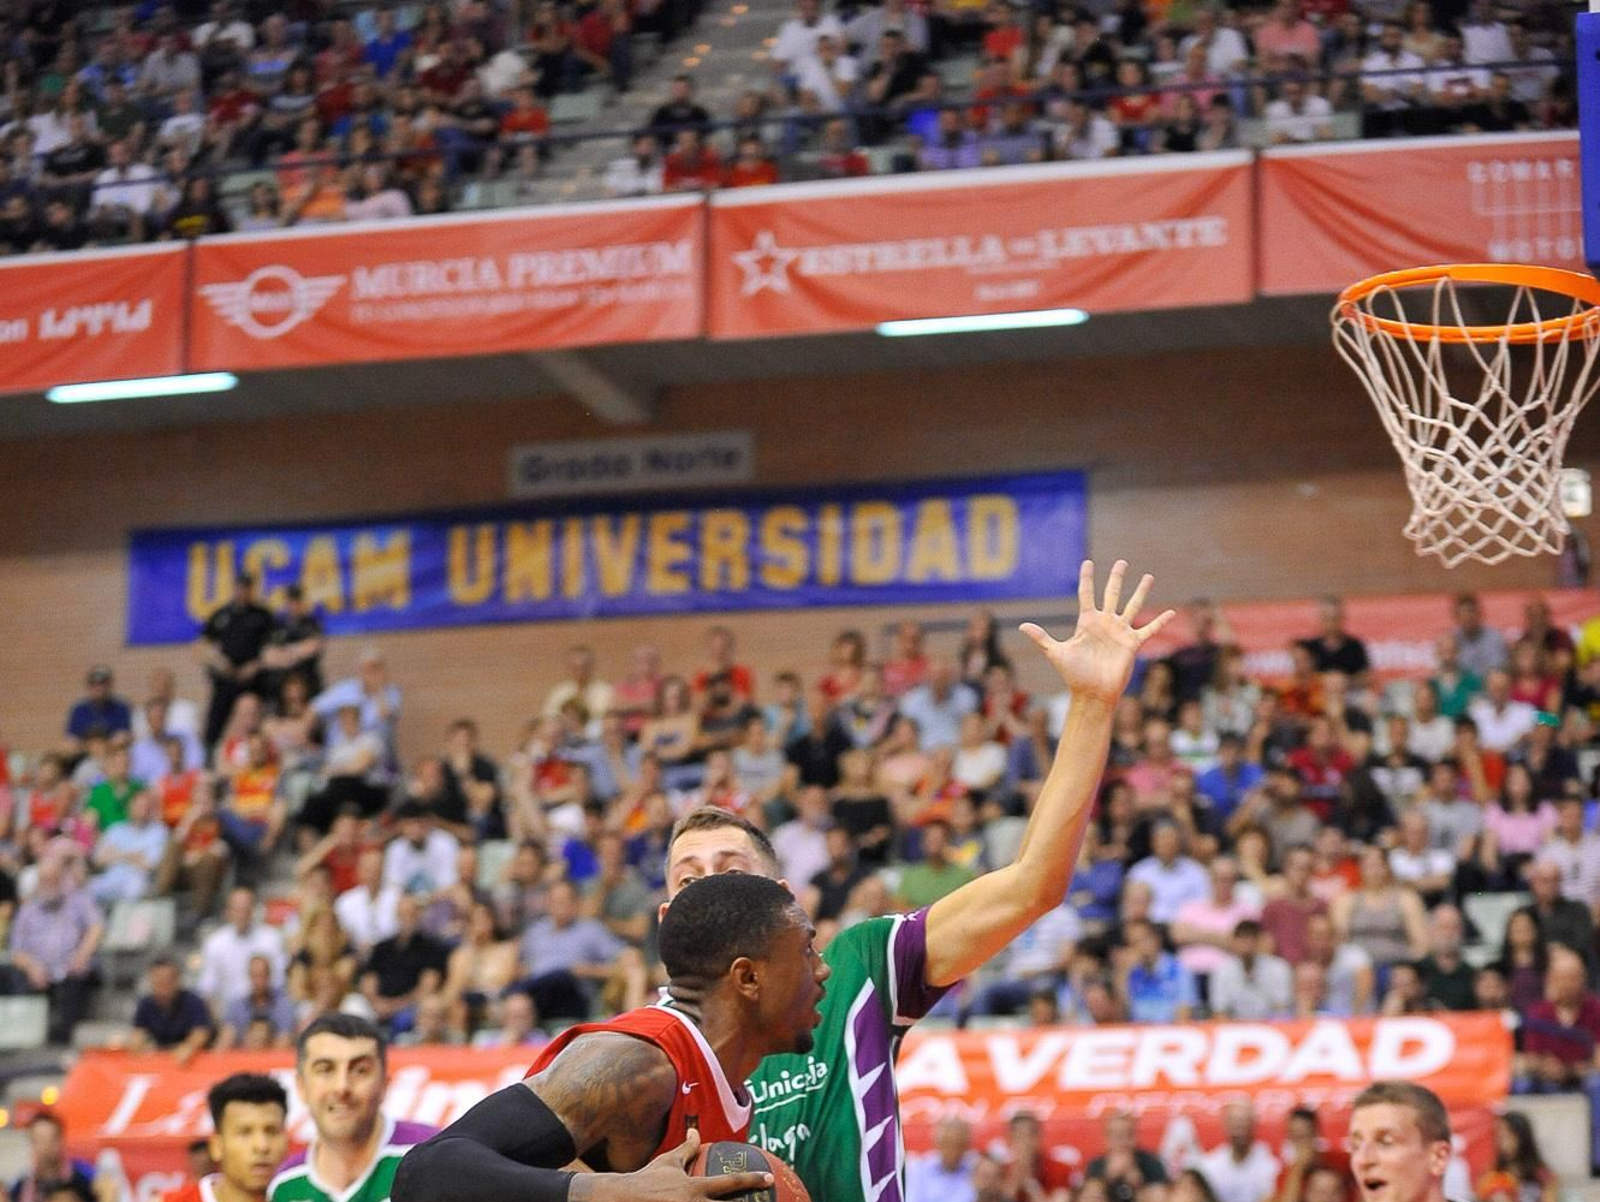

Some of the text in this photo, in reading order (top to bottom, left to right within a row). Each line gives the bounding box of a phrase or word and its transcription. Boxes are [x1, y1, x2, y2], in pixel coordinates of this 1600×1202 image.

[352, 256, 497, 299] MURCIA
[799, 233, 1004, 276] ESTRELLA
[1036, 215, 1228, 261] LEVANTE
[185, 496, 1018, 622] UCAM UNIVERSIDAD
[984, 1014, 1457, 1093] VERDAD
